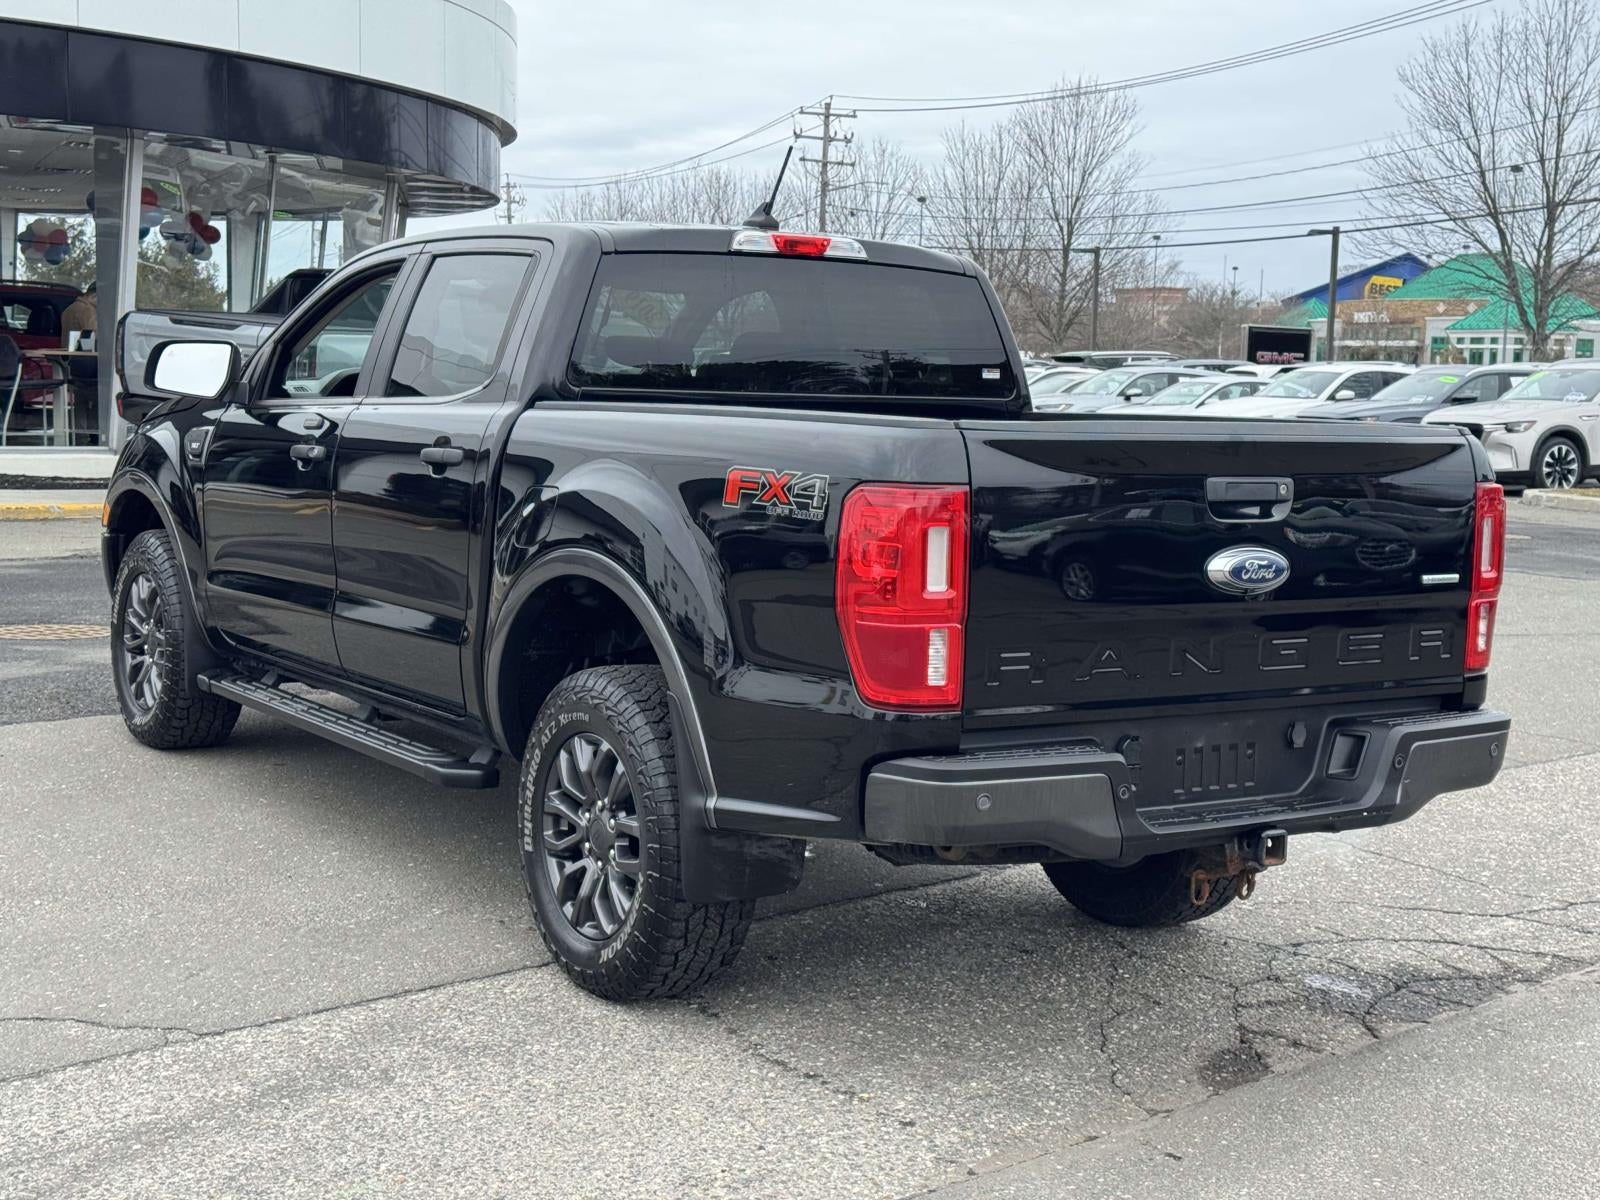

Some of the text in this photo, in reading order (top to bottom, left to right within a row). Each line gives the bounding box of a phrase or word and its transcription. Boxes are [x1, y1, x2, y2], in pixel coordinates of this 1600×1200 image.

[1256, 352, 1305, 363] GMC
[722, 465, 830, 512] FX4
[1241, 559, 1277, 580] Ford
[985, 623, 1454, 687] RANGER
